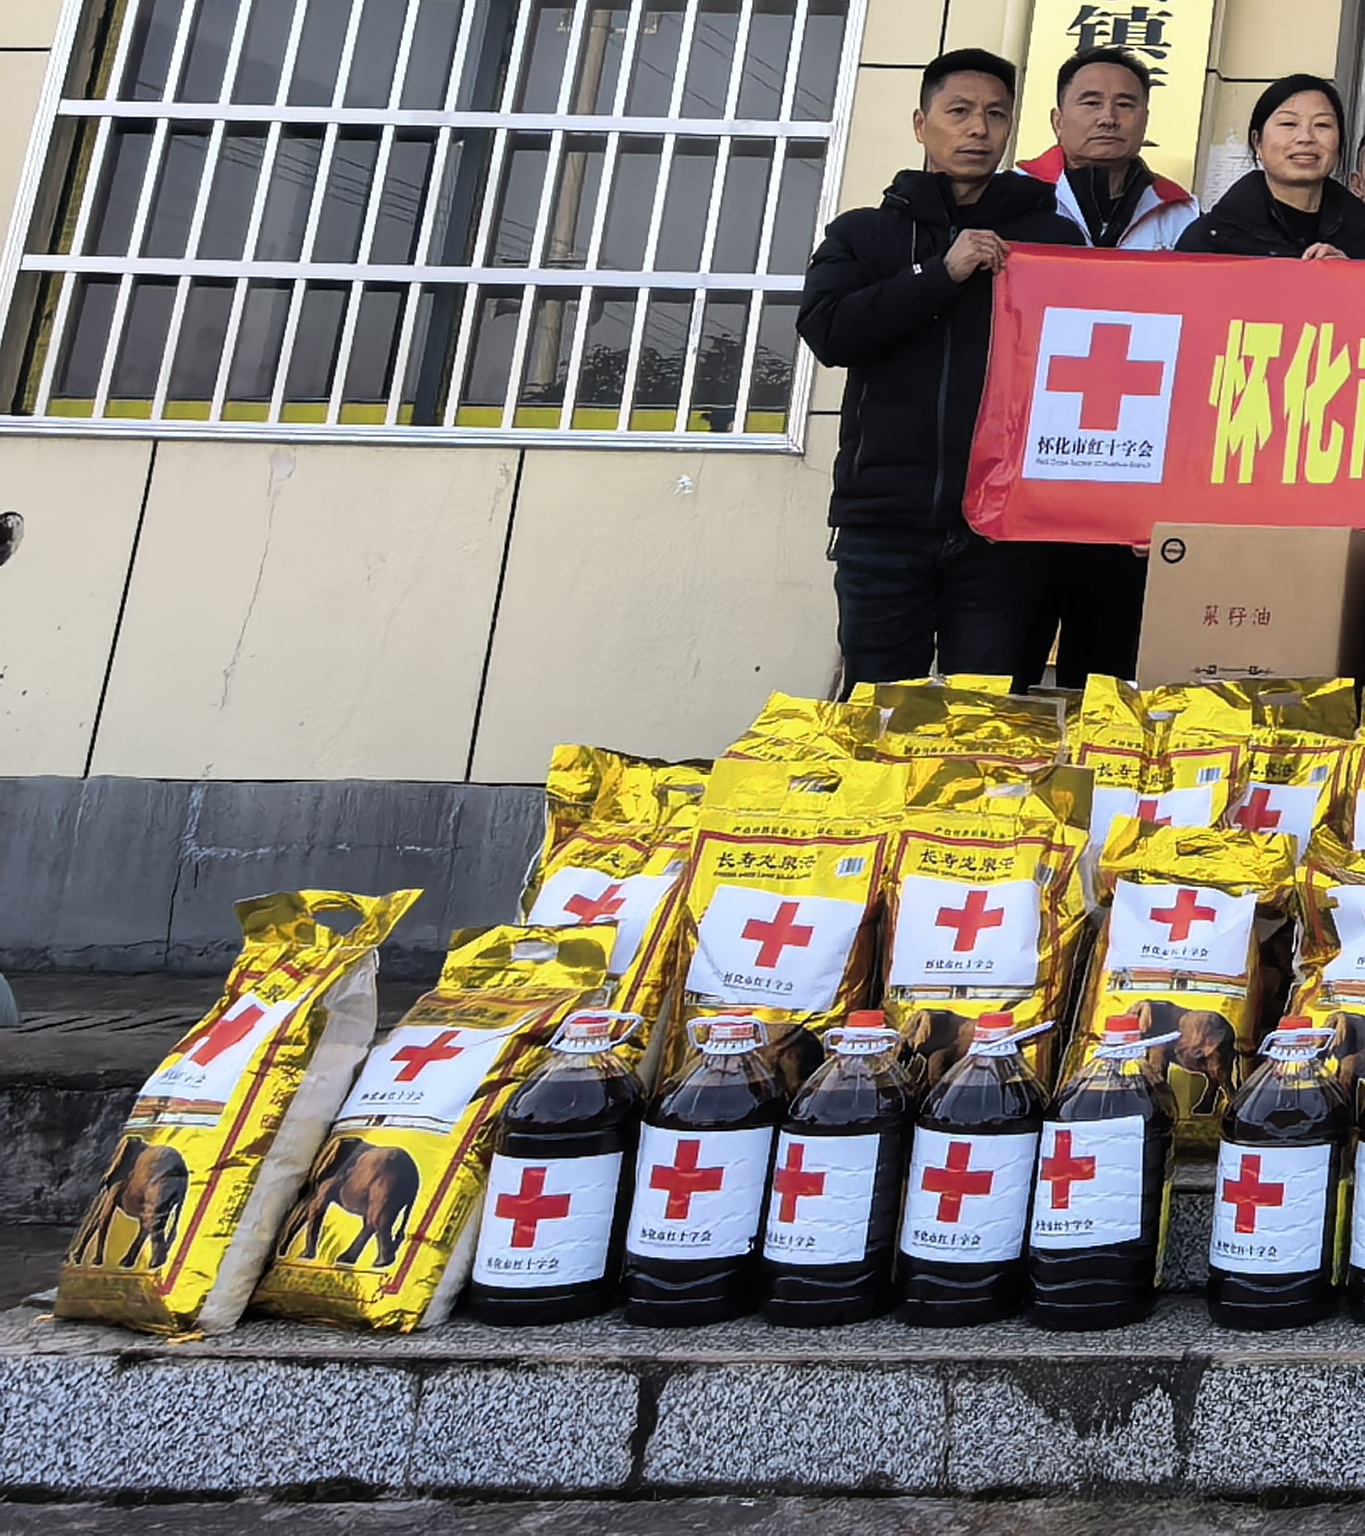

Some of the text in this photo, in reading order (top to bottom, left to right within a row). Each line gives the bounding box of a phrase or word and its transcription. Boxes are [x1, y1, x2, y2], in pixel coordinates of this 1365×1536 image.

[1037, 435, 1154, 458] 怀化市红十字会
